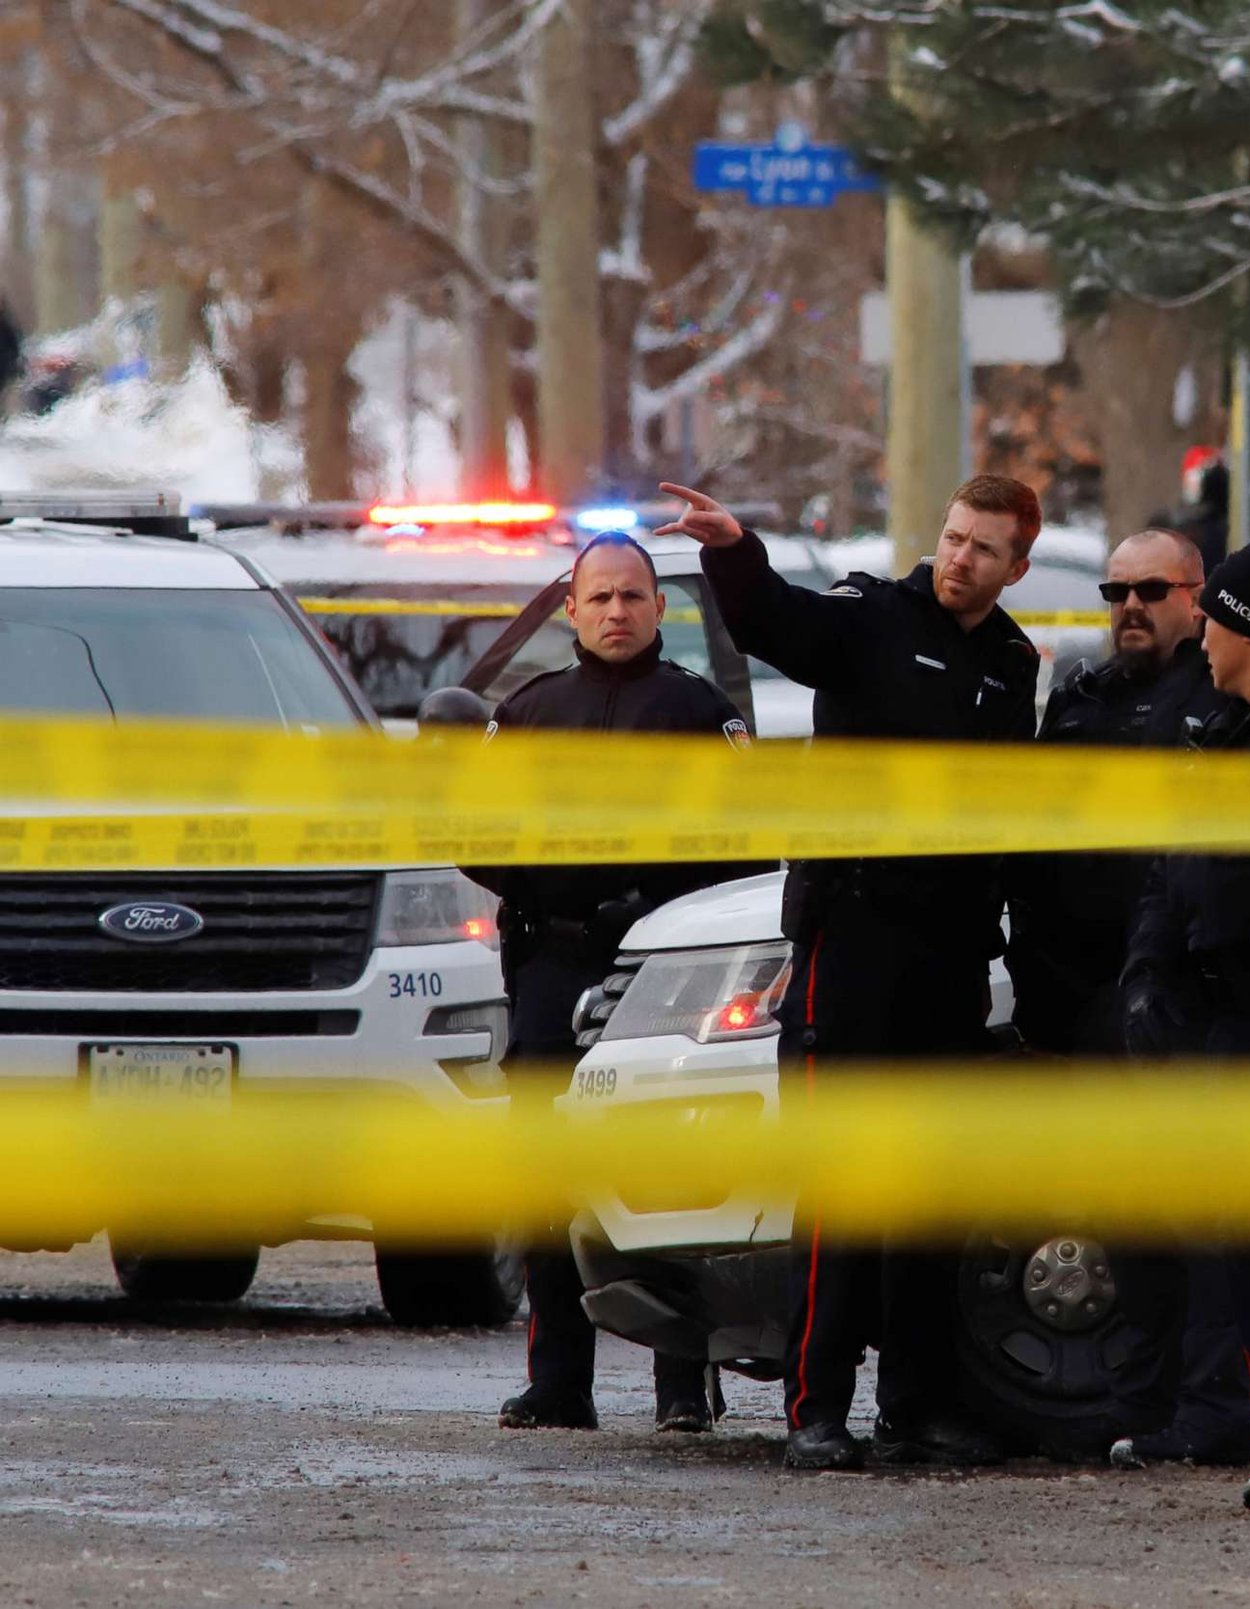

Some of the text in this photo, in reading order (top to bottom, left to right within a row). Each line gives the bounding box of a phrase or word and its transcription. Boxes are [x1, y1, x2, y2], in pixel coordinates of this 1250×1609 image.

[125, 907, 179, 929] Ford
[389, 972, 442, 998] 3410
[577, 1068, 617, 1099] 3499
